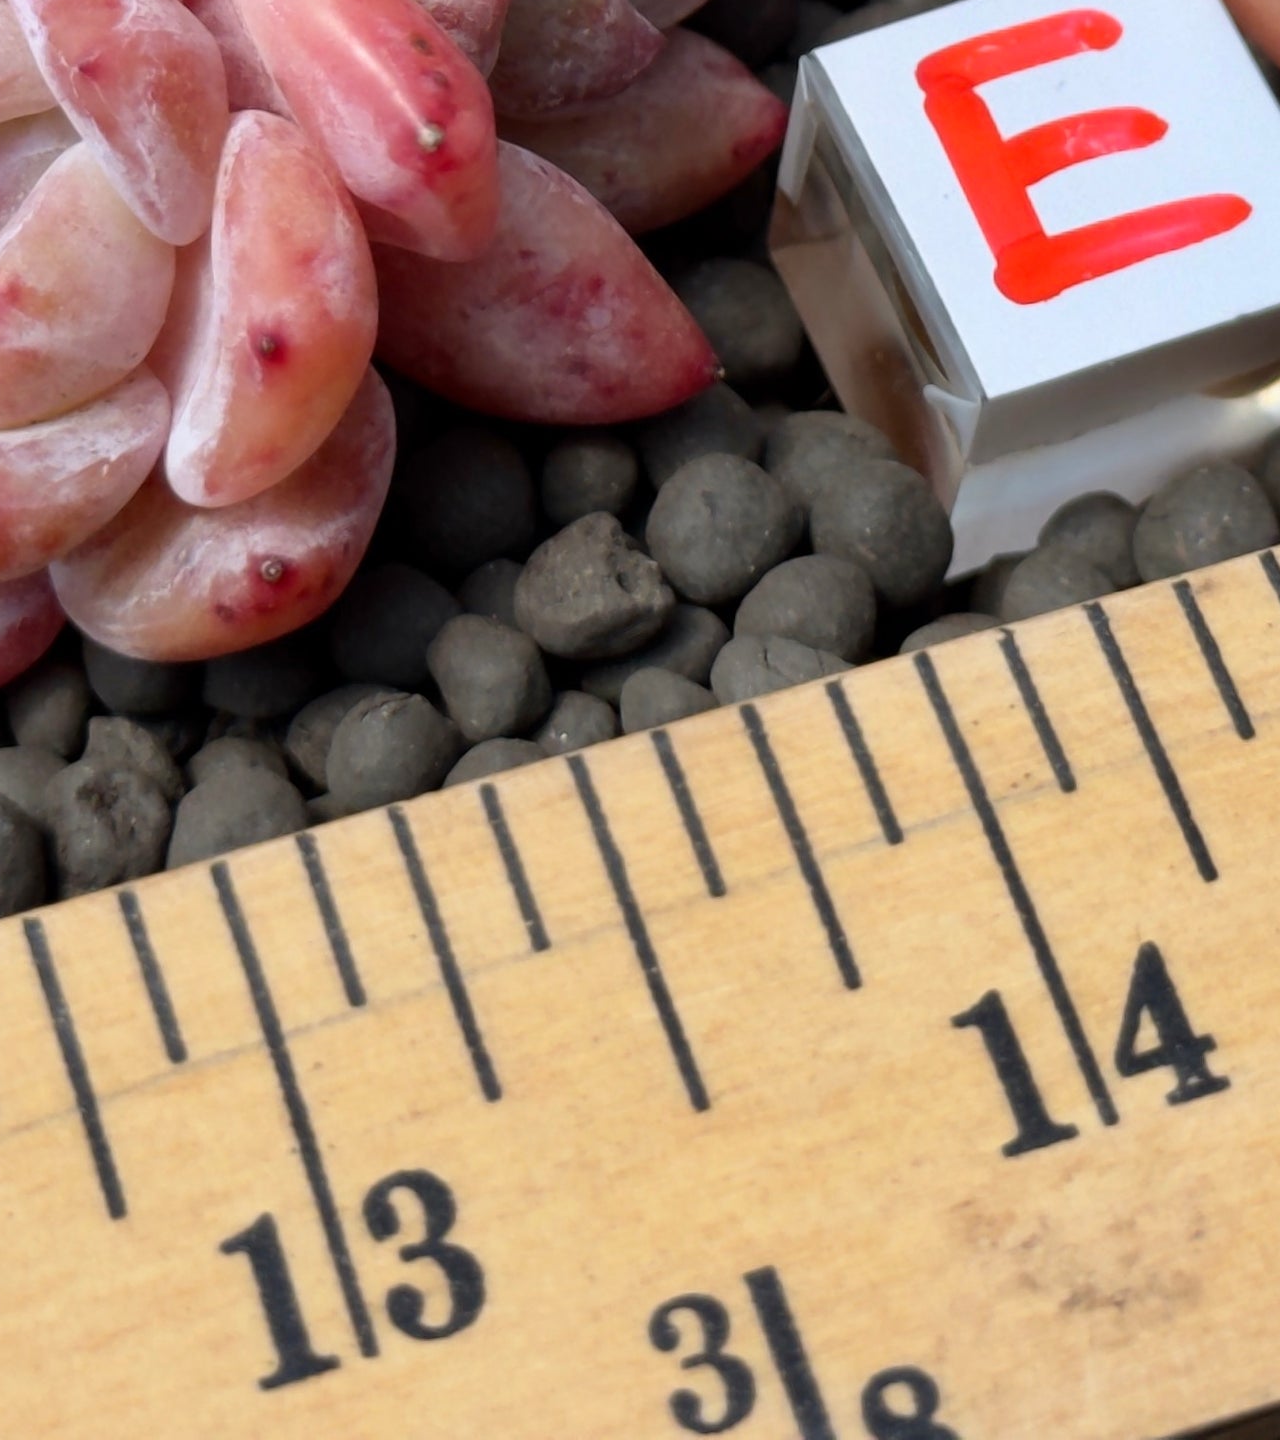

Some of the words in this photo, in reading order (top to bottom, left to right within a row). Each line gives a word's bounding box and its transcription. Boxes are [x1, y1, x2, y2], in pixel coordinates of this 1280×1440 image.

[914, 8, 1254, 306] E
[950, 940, 1230, 1156] 14
[220, 1168, 485, 1391] 13
